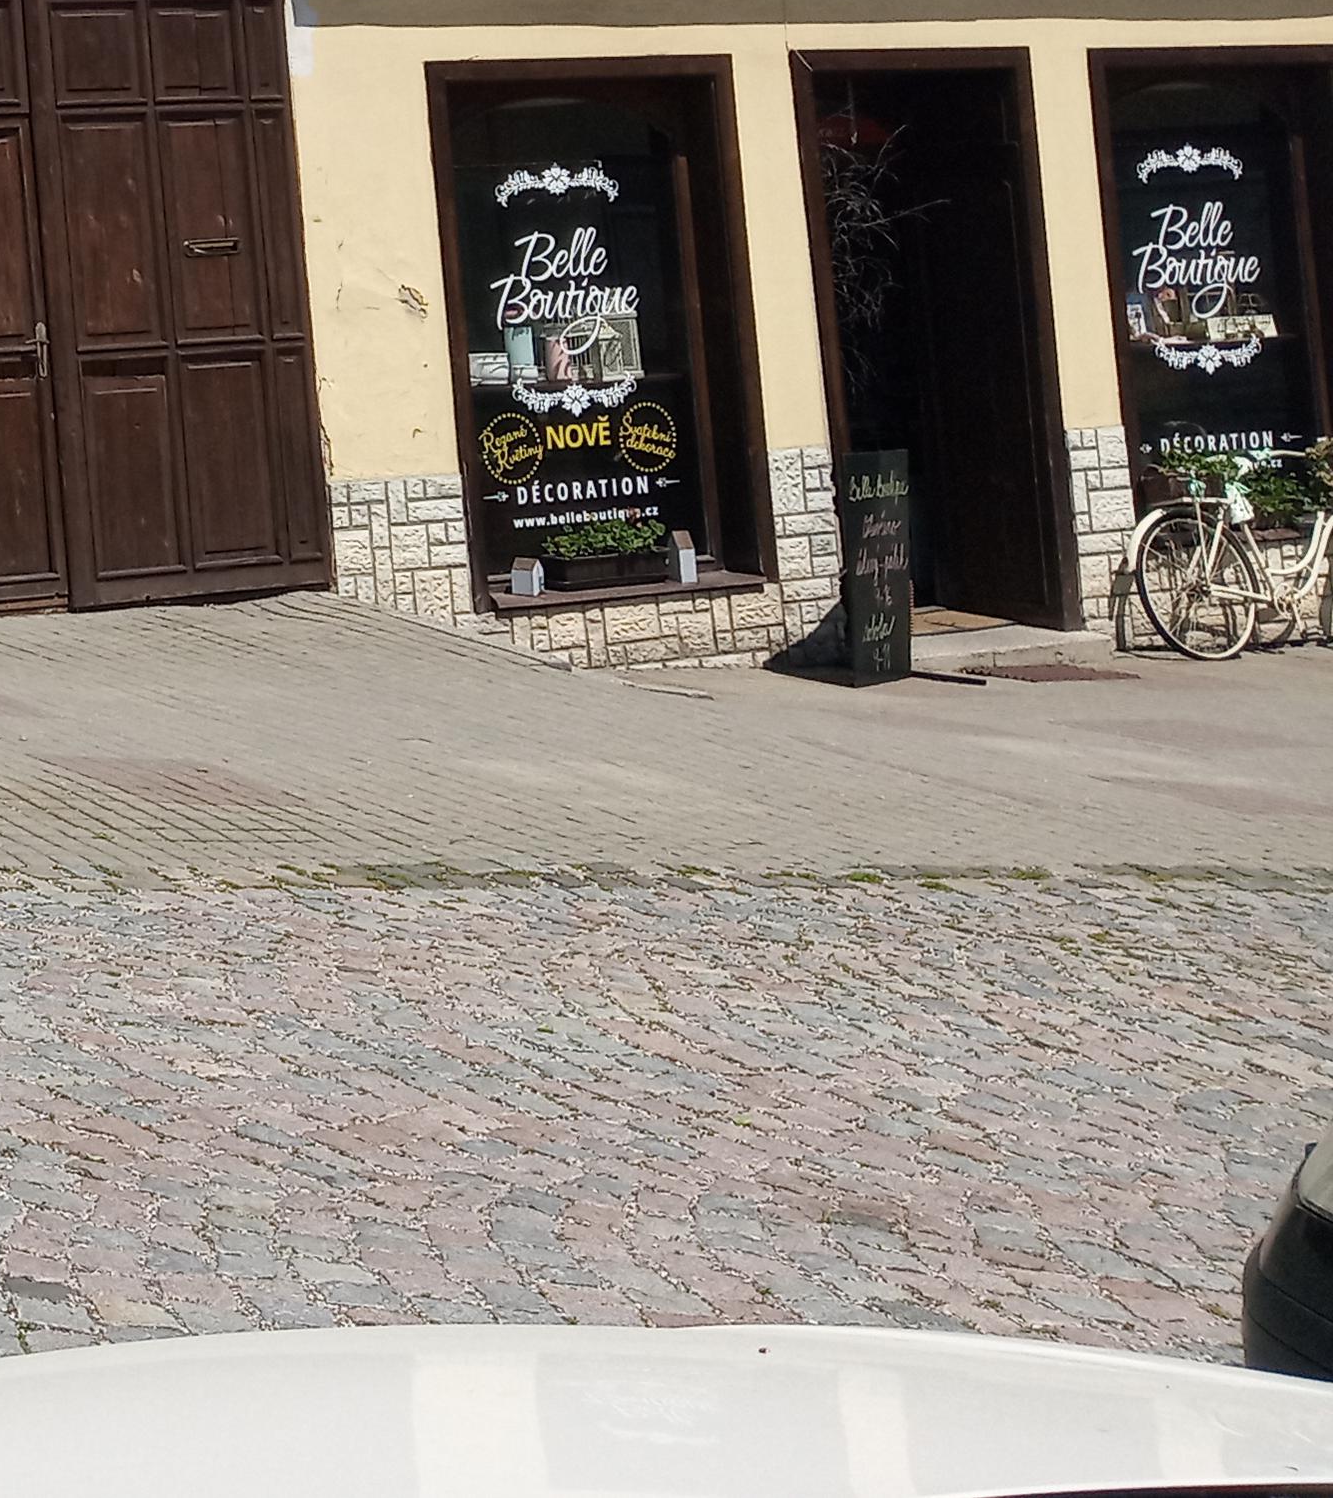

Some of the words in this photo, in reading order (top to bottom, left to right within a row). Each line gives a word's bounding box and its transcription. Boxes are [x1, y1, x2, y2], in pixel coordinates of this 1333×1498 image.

[1150, 201, 1234, 251] Belle
[514, 226, 608, 283] Belle
[1131, 242, 1261, 319] Boutique
[489, 274, 640, 355] Boutique
[546, 414, 612, 450] NOVĚ
[1159, 430, 1275, 453] DÉCORATION
[516, 474, 650, 506] DÉCORATION
